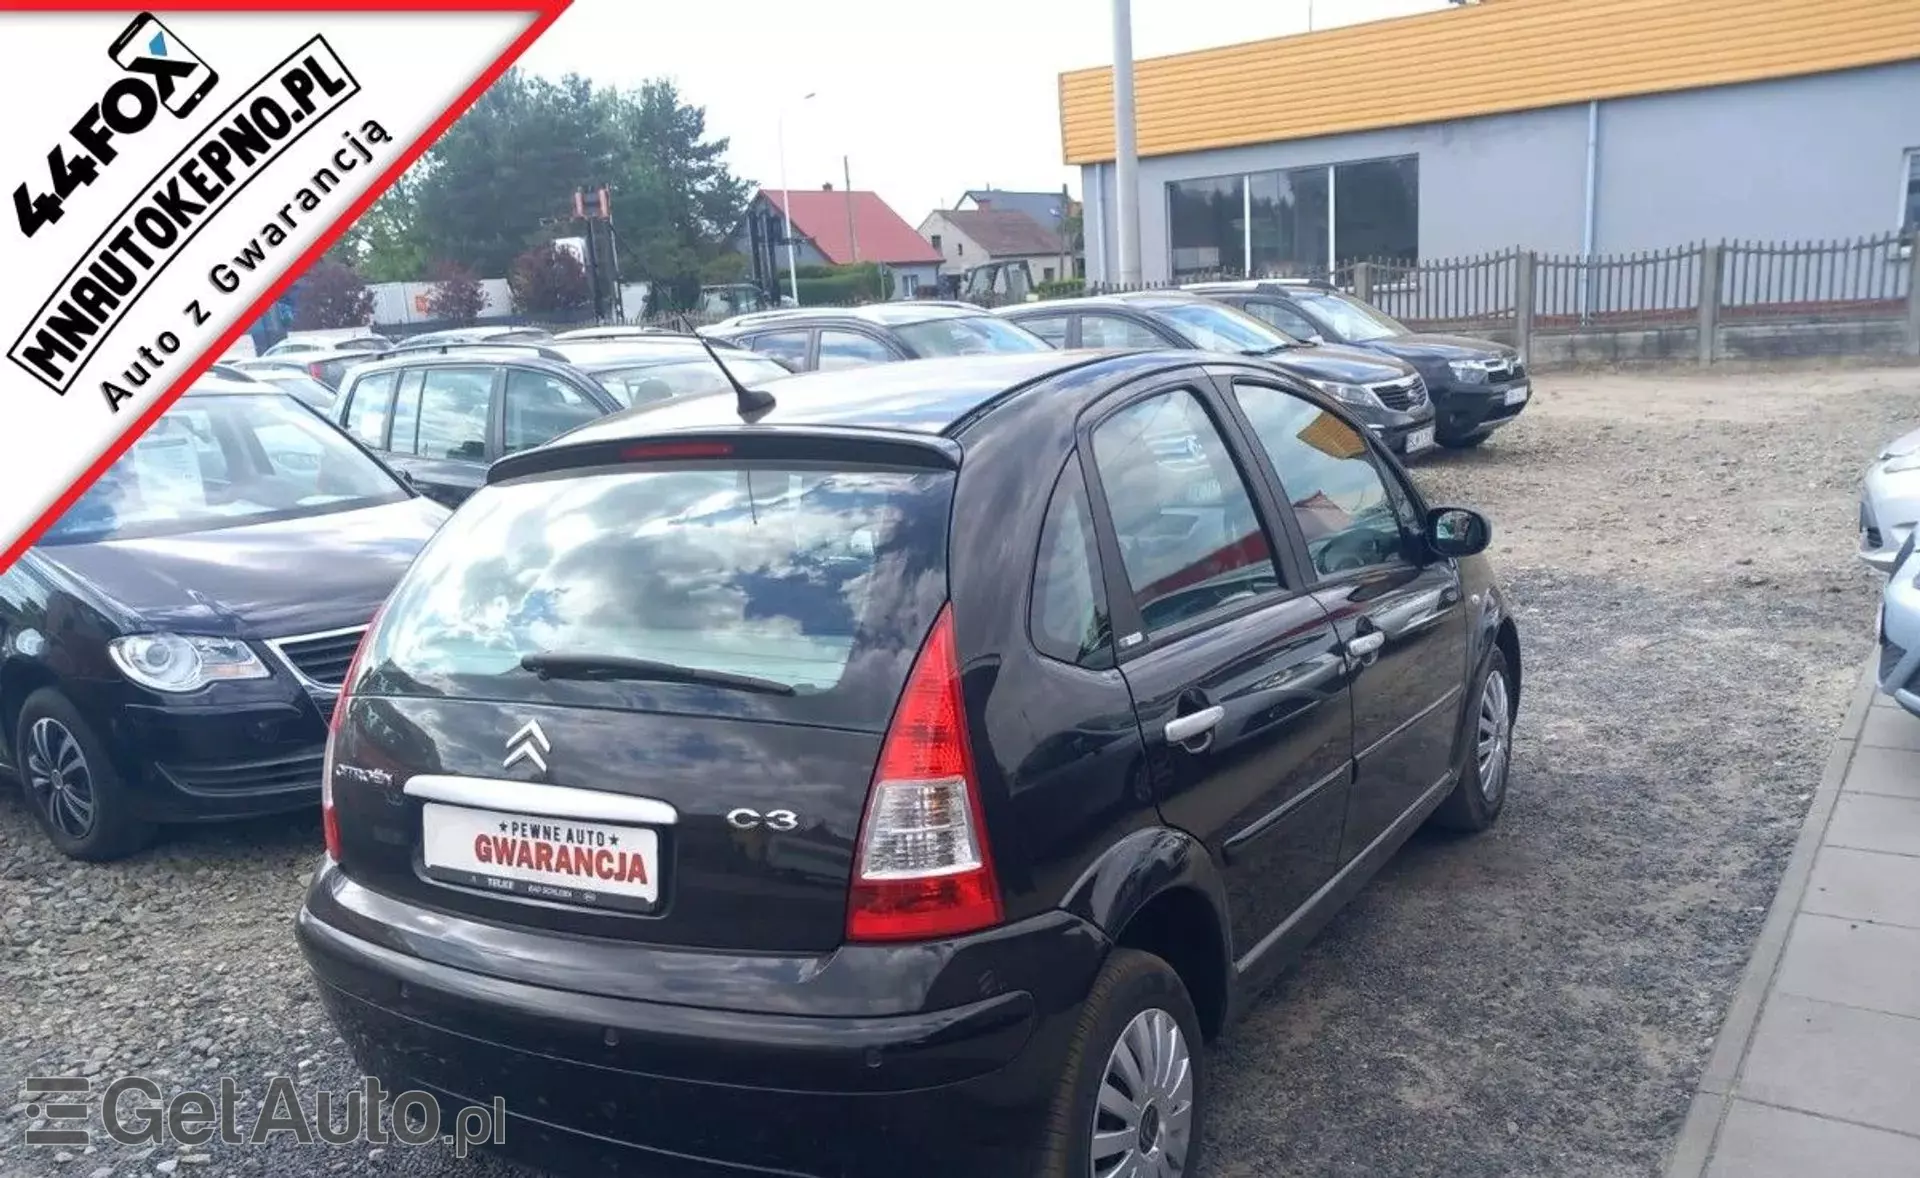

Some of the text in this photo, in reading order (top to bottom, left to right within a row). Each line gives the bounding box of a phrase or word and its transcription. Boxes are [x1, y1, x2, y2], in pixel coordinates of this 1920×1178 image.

[726, 808, 799, 831] C3
[511, 821, 605, 847] PEWNE AUTO
[475, 833, 647, 884] GWARANCJA
